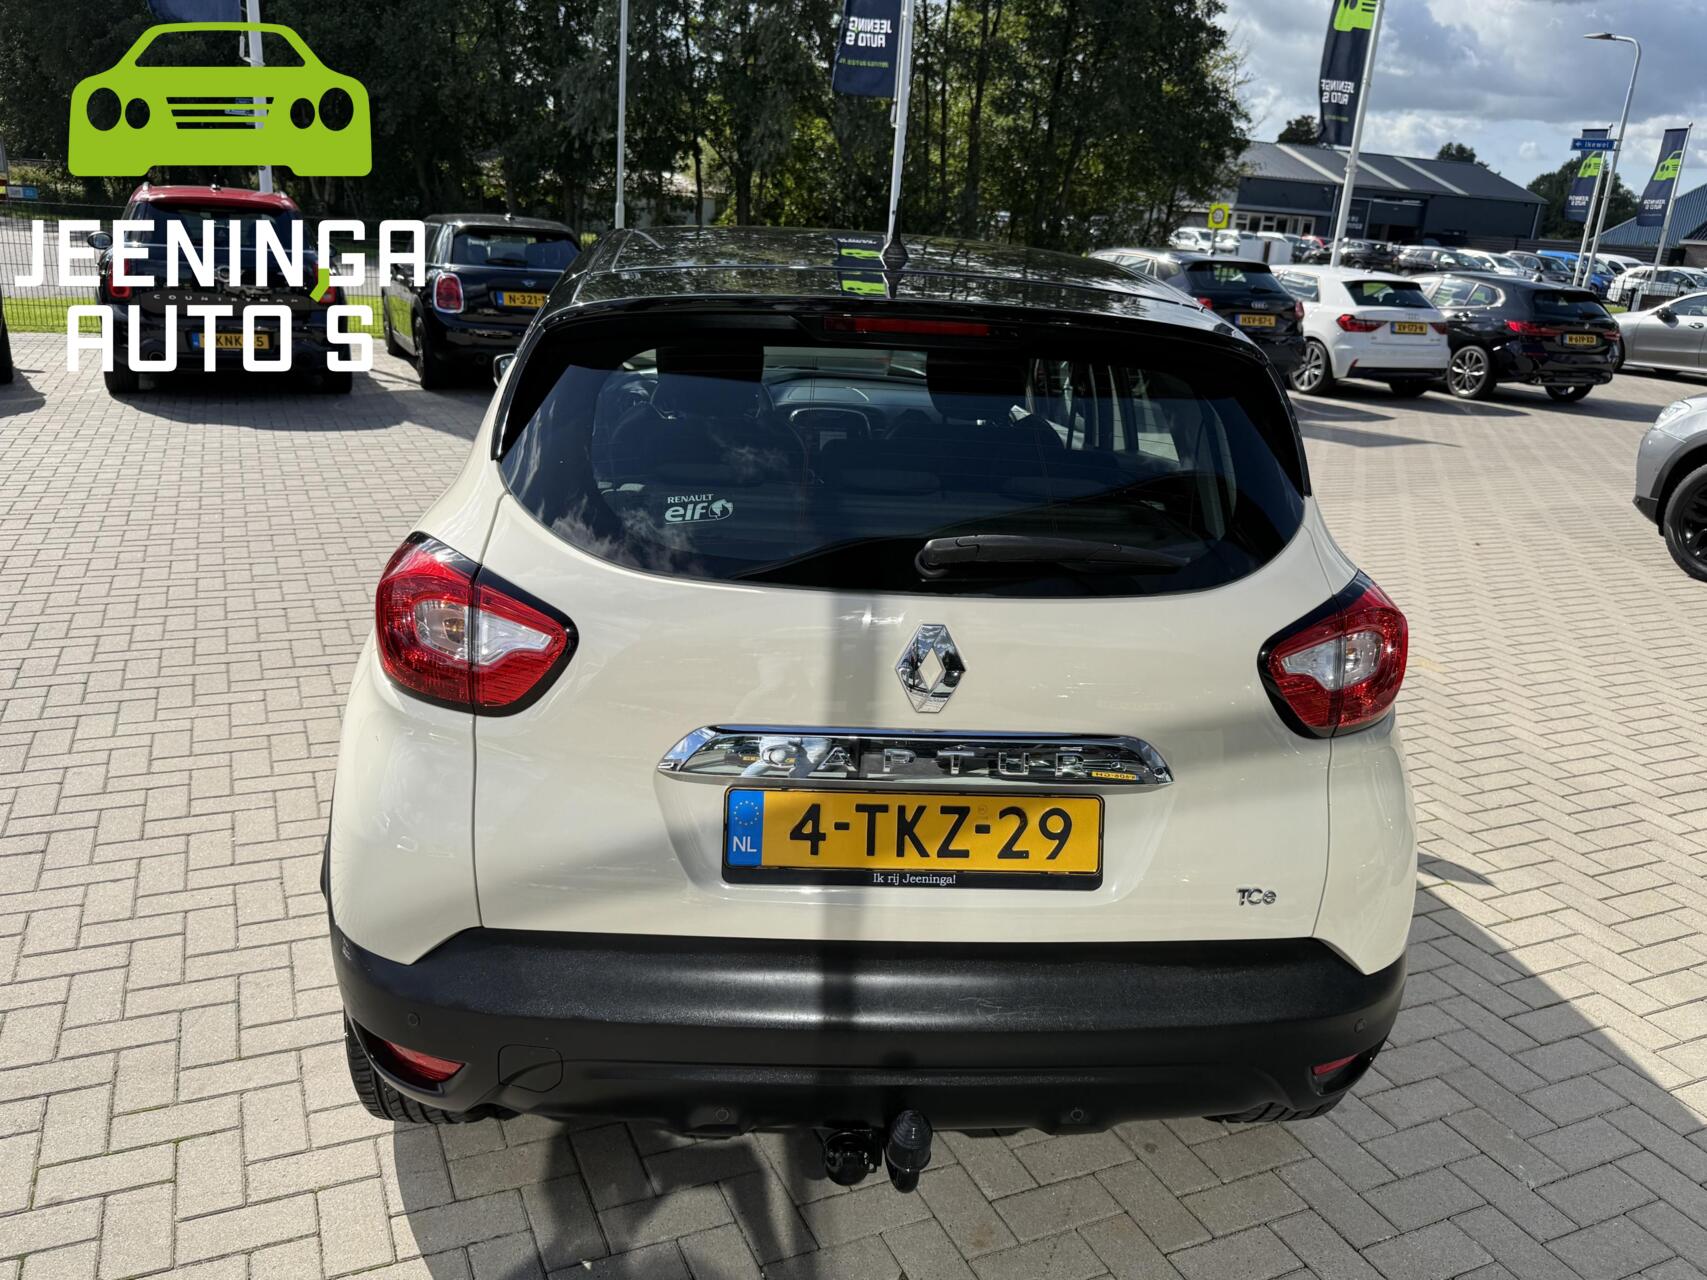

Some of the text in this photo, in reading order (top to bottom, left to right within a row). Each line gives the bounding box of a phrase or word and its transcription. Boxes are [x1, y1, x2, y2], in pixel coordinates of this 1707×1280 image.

[153, 294, 298, 303] COUNTRYMAN
[667, 493, 714, 504] RENAULT
[664, 502, 708, 521] elf
[760, 745, 1087, 777] CAPTUR
[789, 803, 1073, 861] 4-TKZ-29
[732, 836, 758, 853] NL
[873, 873, 956, 887] Ik rij Jeeninga!
[1236, 888, 1277, 906] TCe
